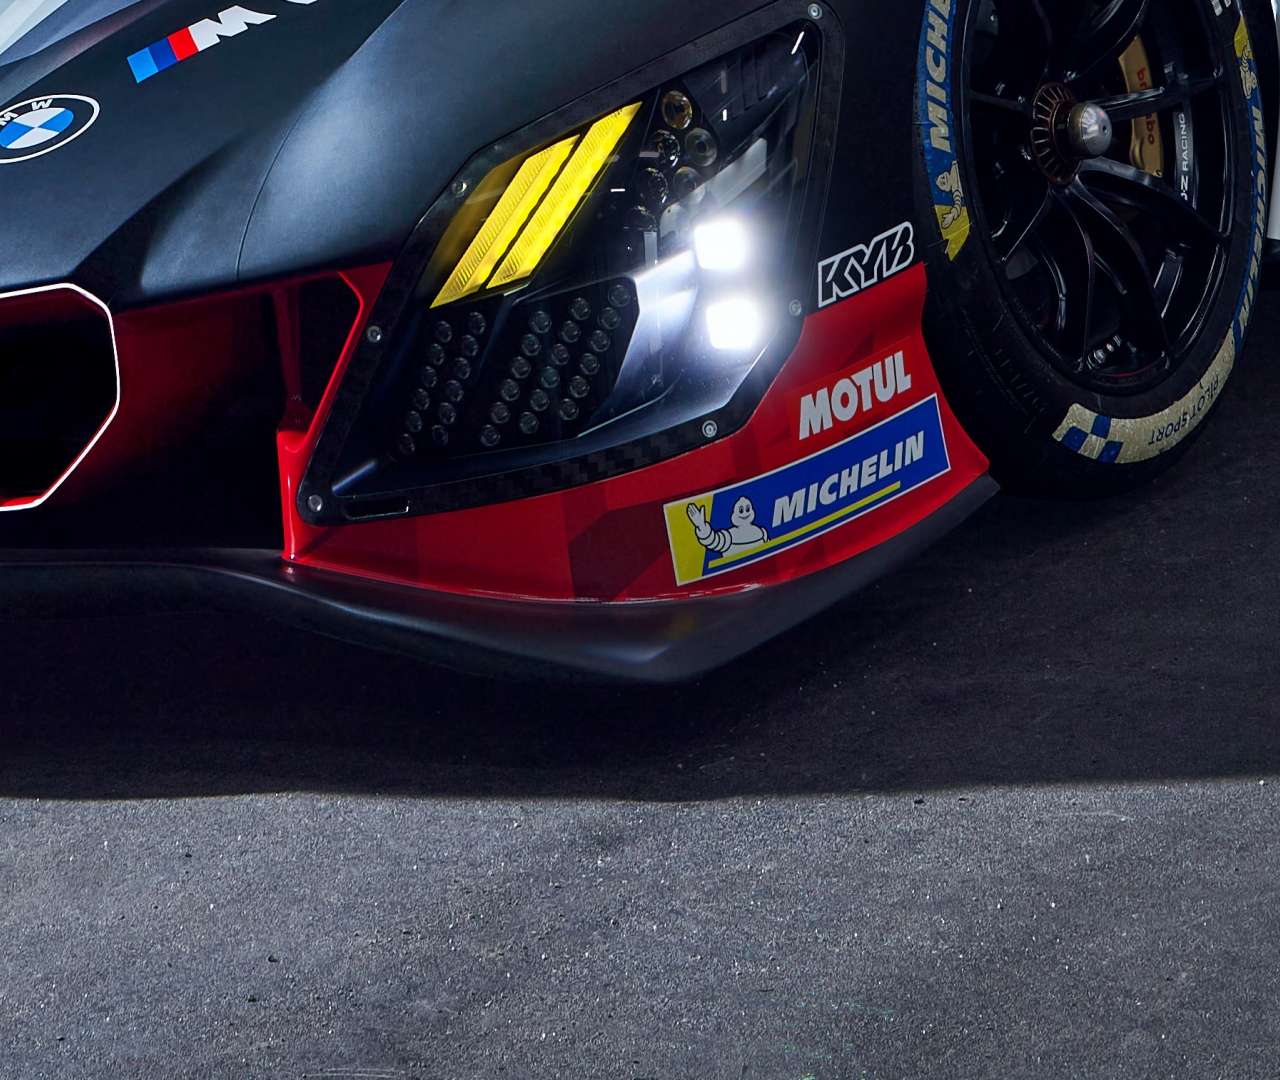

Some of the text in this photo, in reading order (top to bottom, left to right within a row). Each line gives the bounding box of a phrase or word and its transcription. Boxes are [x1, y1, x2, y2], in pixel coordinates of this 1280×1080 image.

[1136, 67, 1156, 145] brbo
[1178, 113, 1189, 171] RACING
[1240, 105, 1267, 332] MICHELIN
[818, 221, 915, 308] KYB
[799, 350, 912, 440] MOTUL
[1148, 374, 1219, 445] PILOT SPORT
[772, 430, 925, 528] MICHELIN
